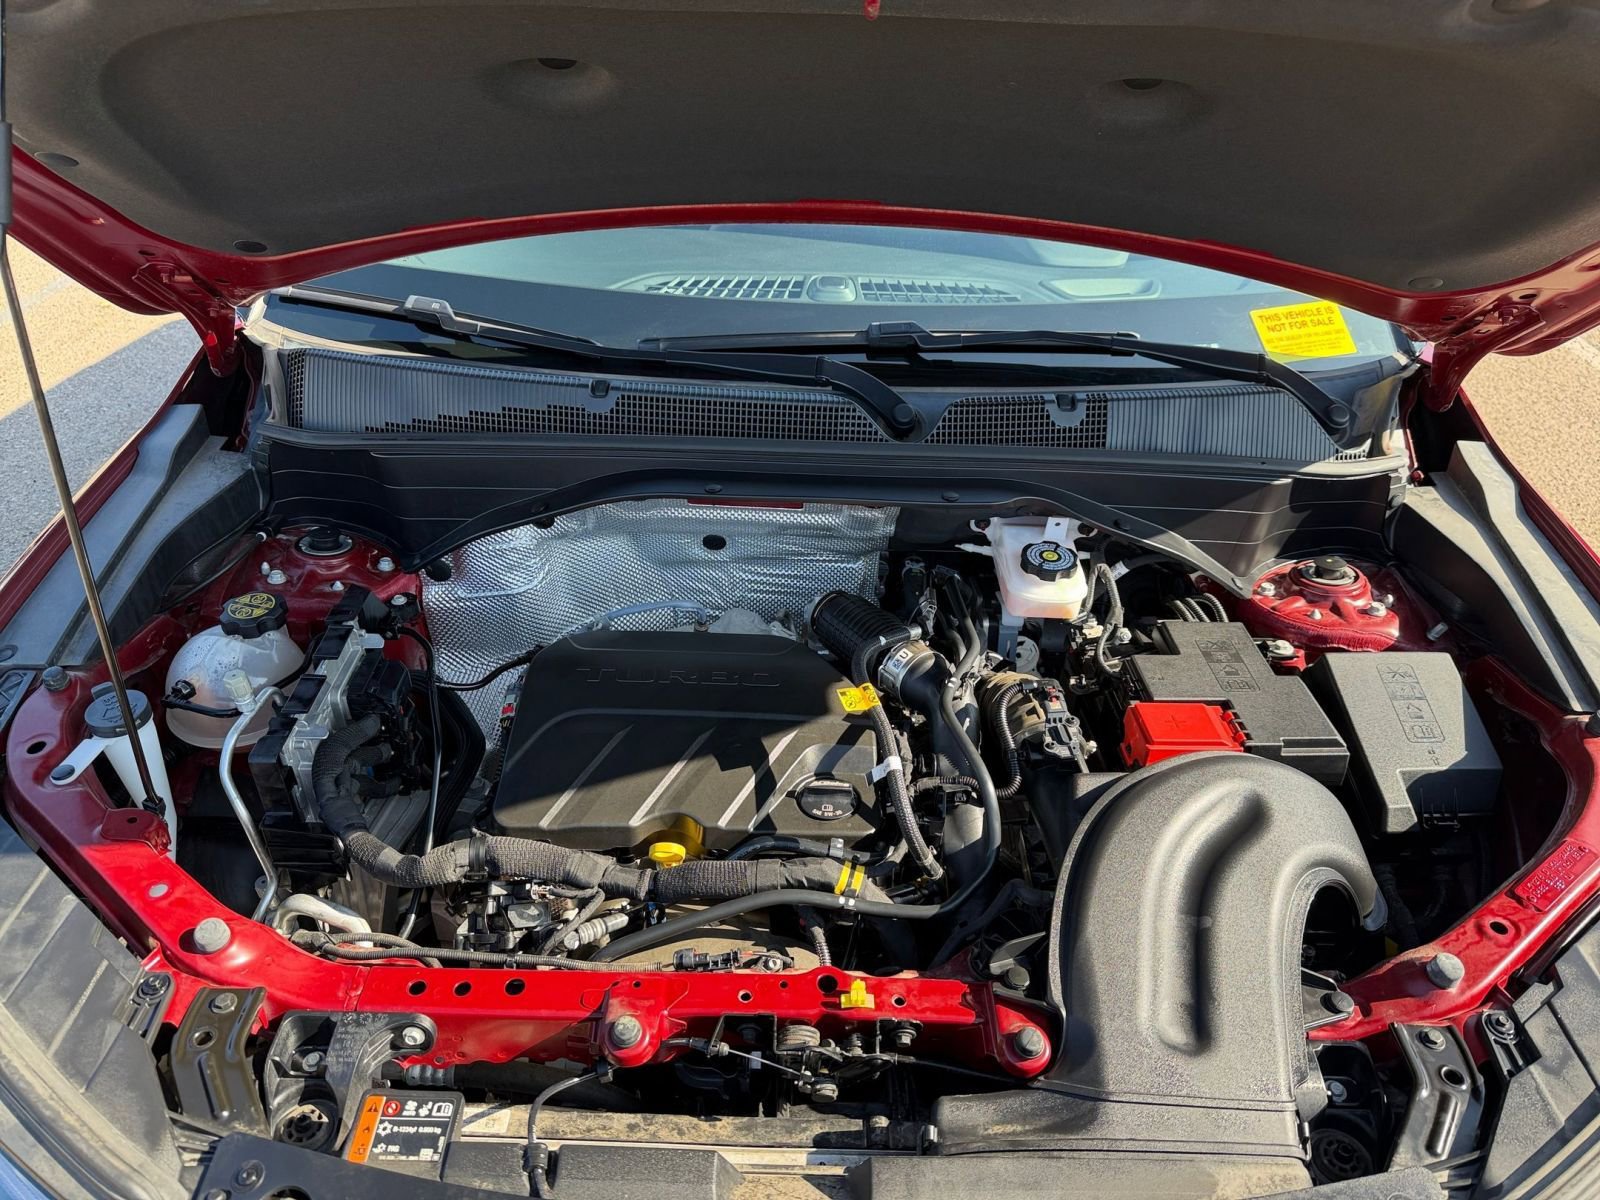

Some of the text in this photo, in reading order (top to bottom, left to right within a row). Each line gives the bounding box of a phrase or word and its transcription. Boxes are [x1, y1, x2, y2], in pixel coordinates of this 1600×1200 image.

[1257, 306, 1335, 324] THIS VEHICLE IS
[1267, 316, 1335, 333] NOT FOR SALE
[576, 668, 781, 687] TURBO
